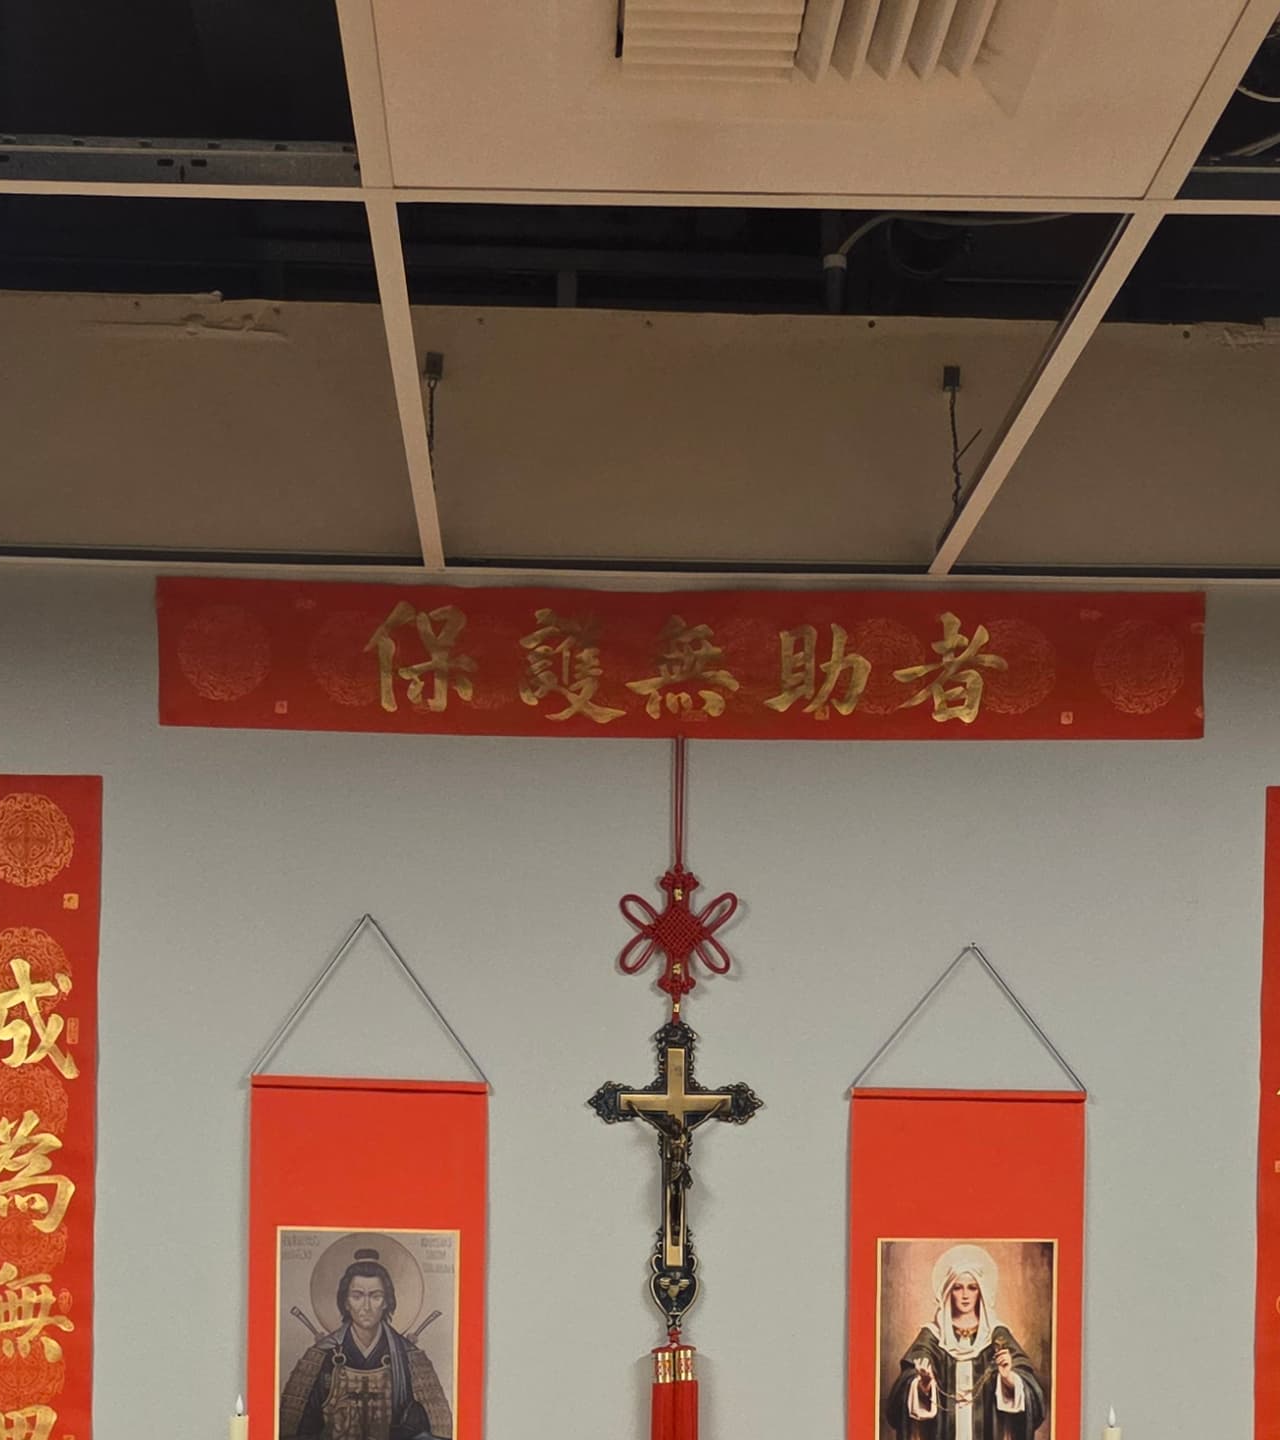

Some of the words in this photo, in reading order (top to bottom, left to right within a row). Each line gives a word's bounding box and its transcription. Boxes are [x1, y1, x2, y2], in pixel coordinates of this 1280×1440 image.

[363, 600, 1010, 724] 保護無助者
